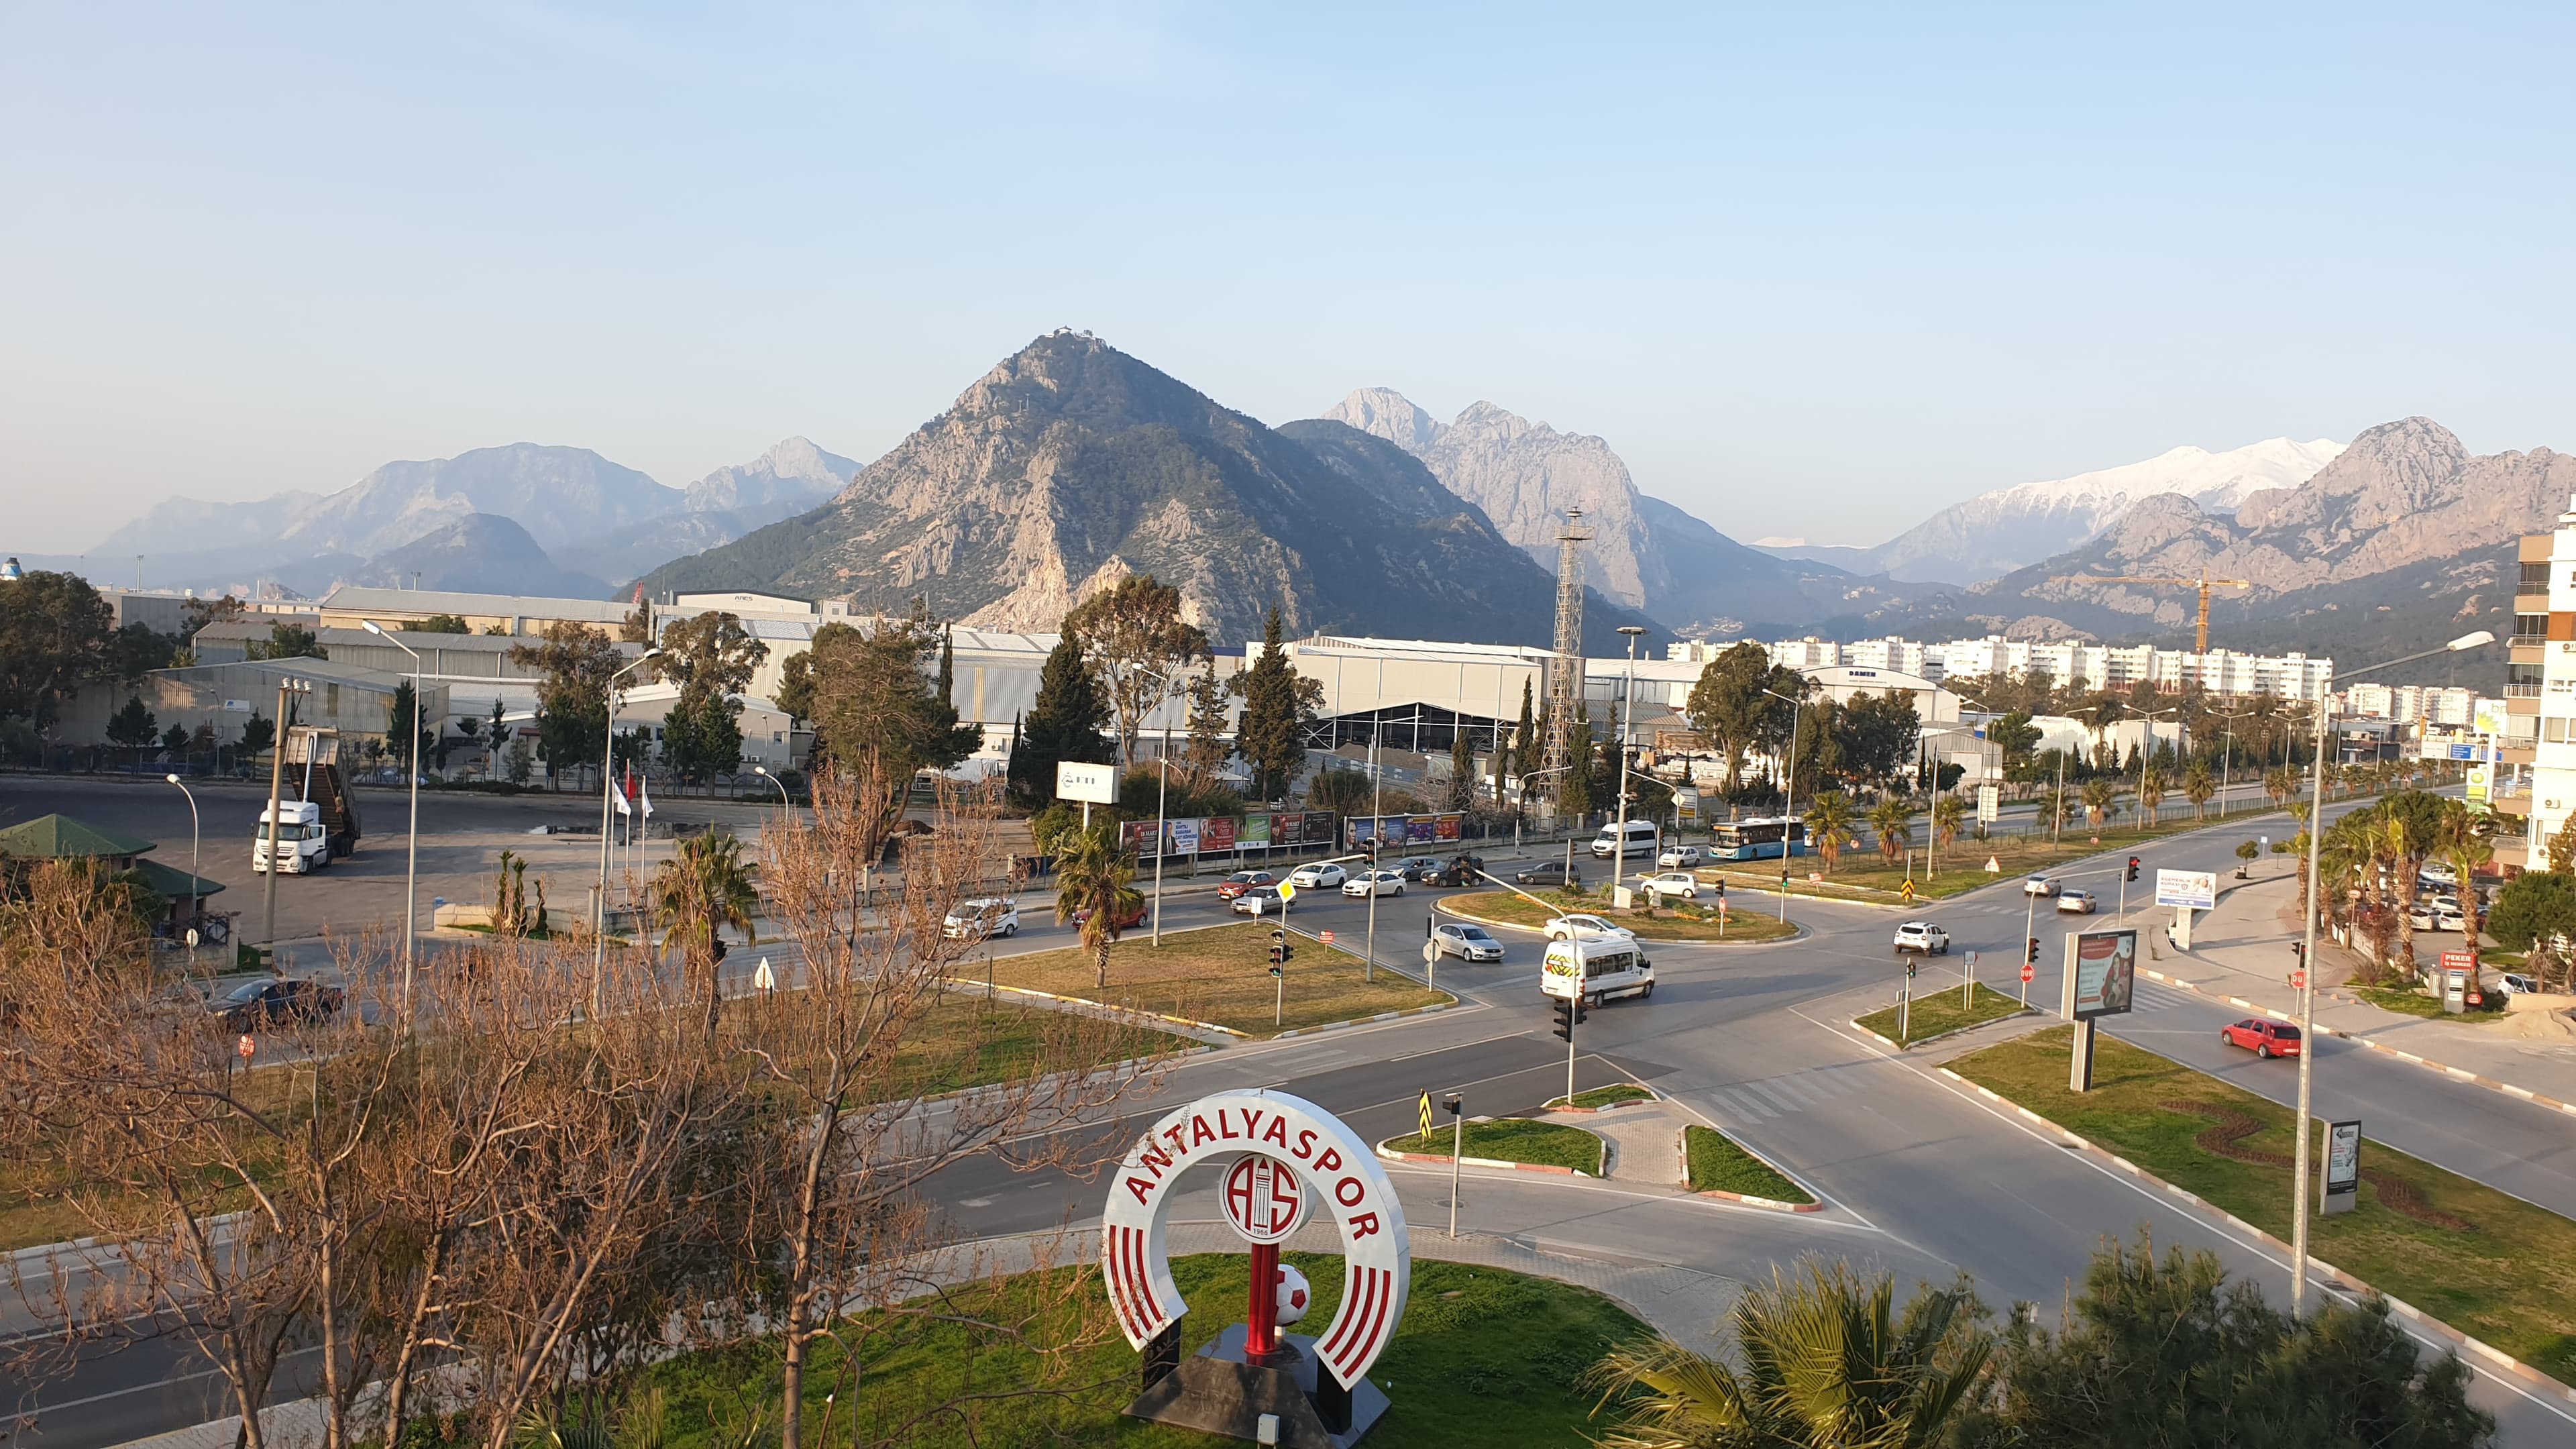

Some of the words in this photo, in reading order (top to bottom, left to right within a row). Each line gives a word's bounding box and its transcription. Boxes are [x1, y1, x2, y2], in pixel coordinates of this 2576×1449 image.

[2491, 703, 2507, 715] bp
[2021, 969, 2033, 977] DUR
[2292, 975, 2303, 983] DU
[1126, 1108, 1379, 1240] ANTALYASPOR
